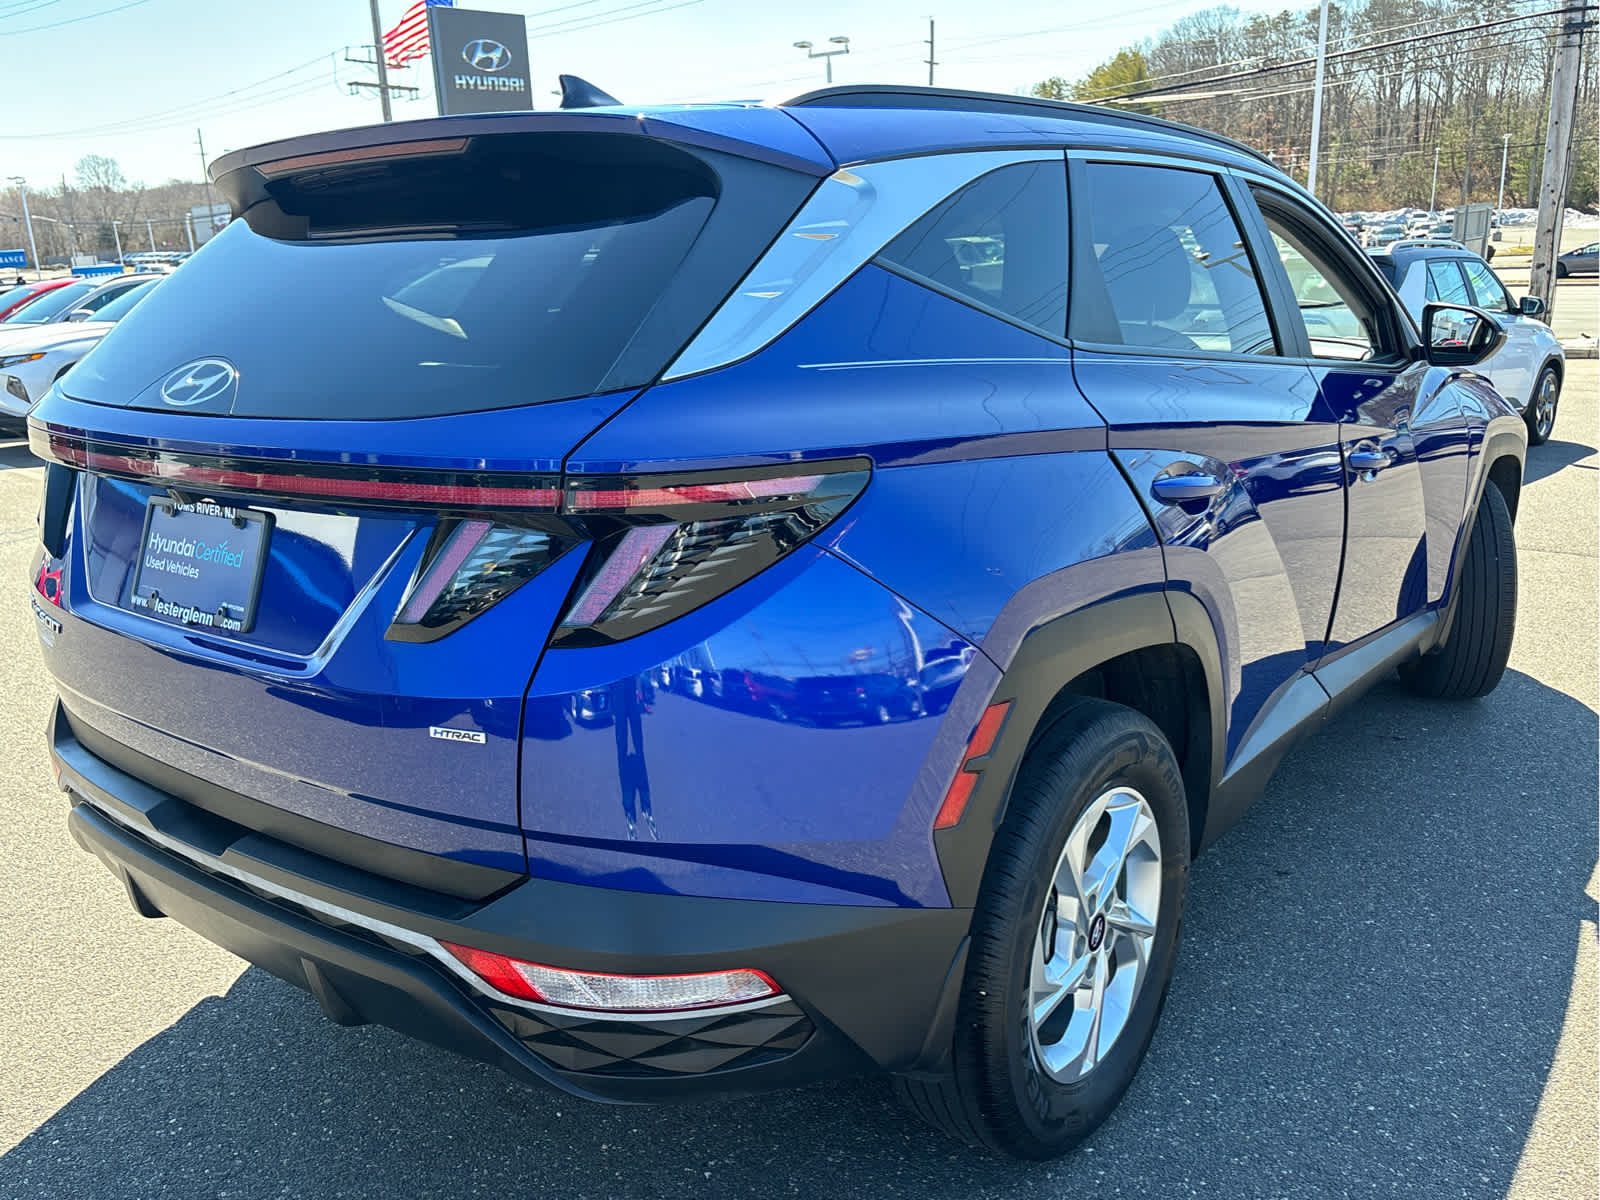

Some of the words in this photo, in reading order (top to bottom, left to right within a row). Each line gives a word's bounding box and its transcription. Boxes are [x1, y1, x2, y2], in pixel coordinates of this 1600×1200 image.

[455, 74, 525, 92] HYUNDAI
[224, 506, 236, 519] NJ
[145, 555, 166, 571] Used
[166, 559, 200, 579] Vehicles
[154, 597, 213, 626] lesterglenn
[433, 728, 481, 742] HTRAC
